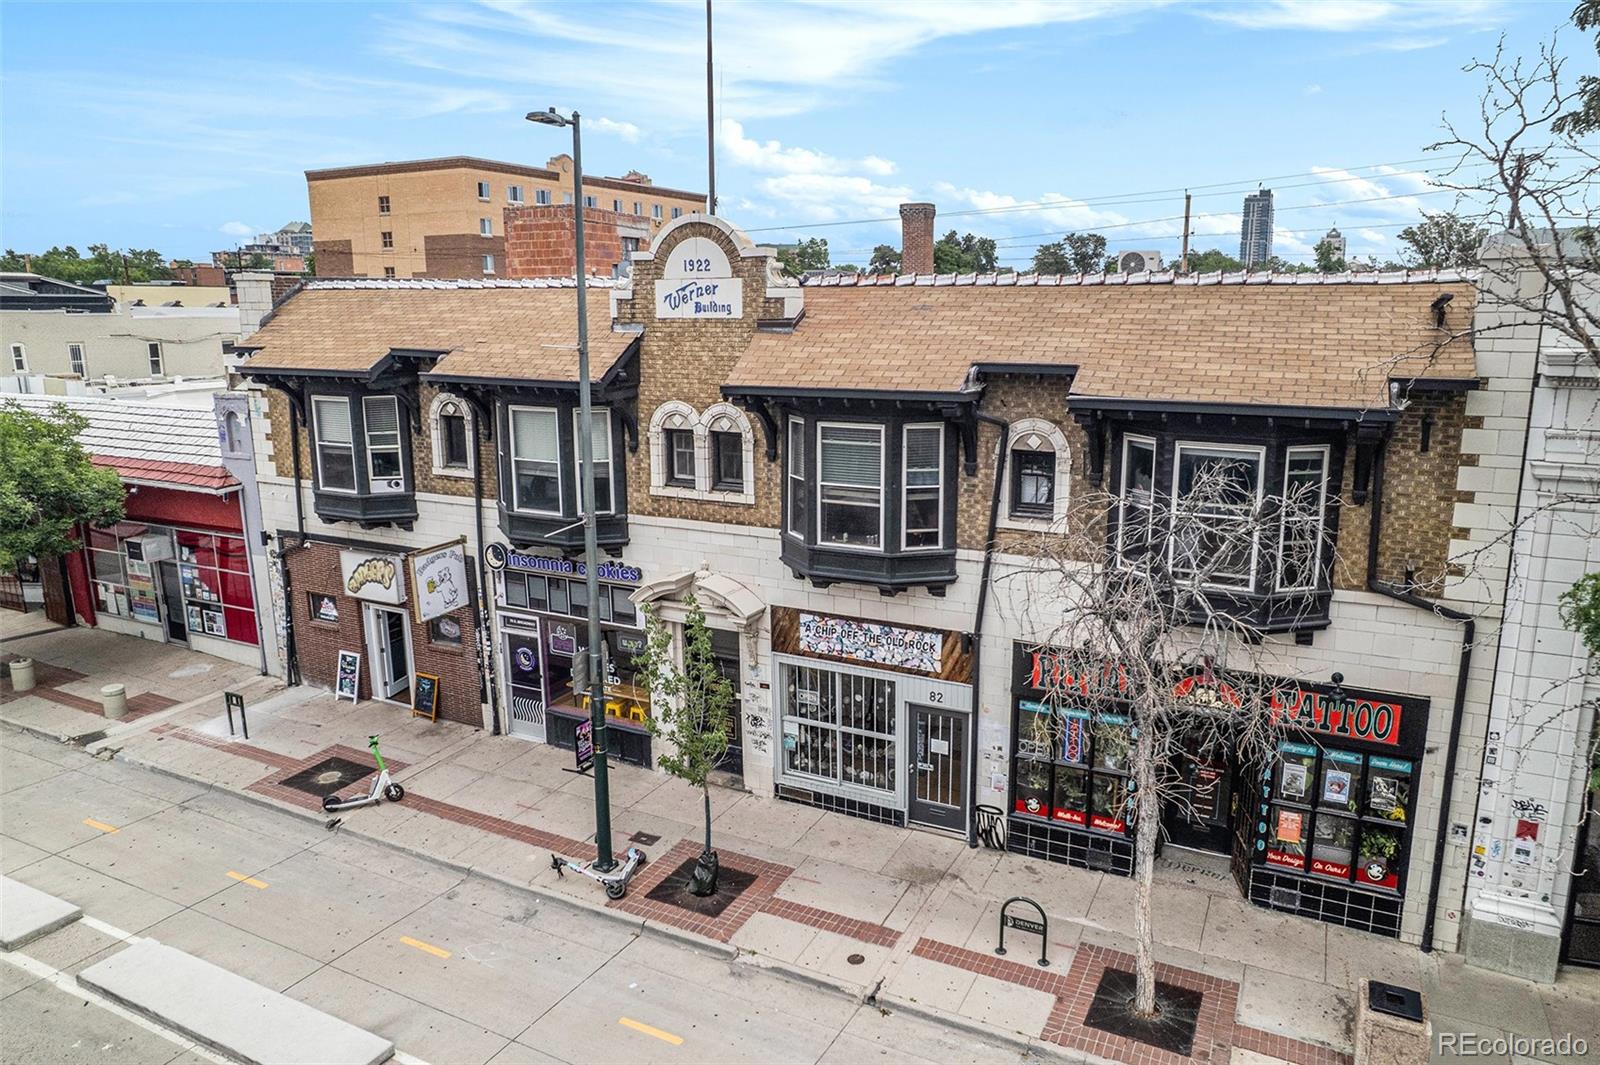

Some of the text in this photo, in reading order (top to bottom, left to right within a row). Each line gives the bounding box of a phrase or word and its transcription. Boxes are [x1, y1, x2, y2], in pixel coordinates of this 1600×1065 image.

[684, 259, 711, 272] 1922
[664, 281, 719, 310] Werner
[694, 301, 732, 315] Building
[507, 552, 639, 582] insomnia cokies
[805, 623, 936, 652] A CHIP OFF THE OLD ROCK
[929, 691, 944, 703] 82
[1275, 689, 1393, 741] TATTOO
[1015, 919, 1044, 931] DENVER
